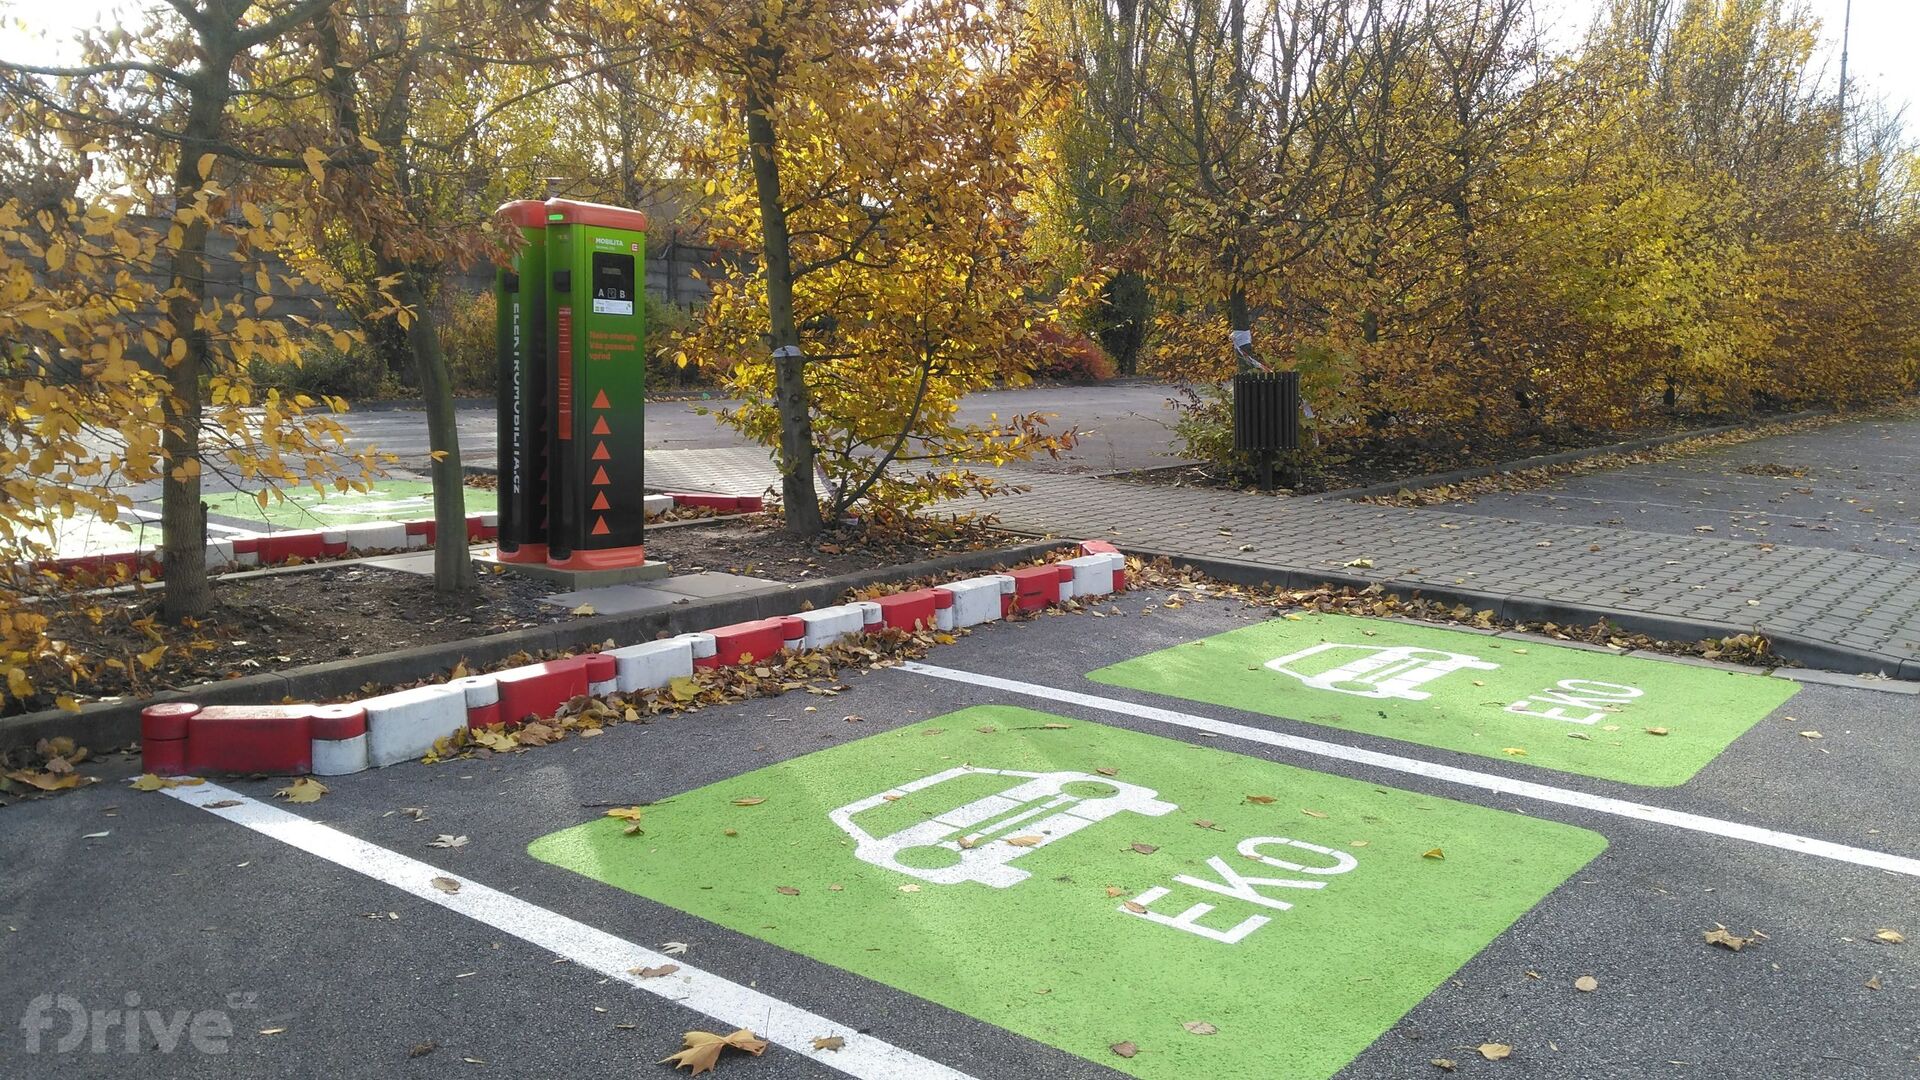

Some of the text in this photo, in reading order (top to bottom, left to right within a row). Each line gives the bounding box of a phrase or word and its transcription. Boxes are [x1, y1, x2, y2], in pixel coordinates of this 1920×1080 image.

[595, 237, 624, 246] MOBILITA
[598, 288, 604, 297] A
[619, 289, 626, 299] B
[1503, 679, 1644, 725] EKO
[1116, 836, 1358, 944] EKO
